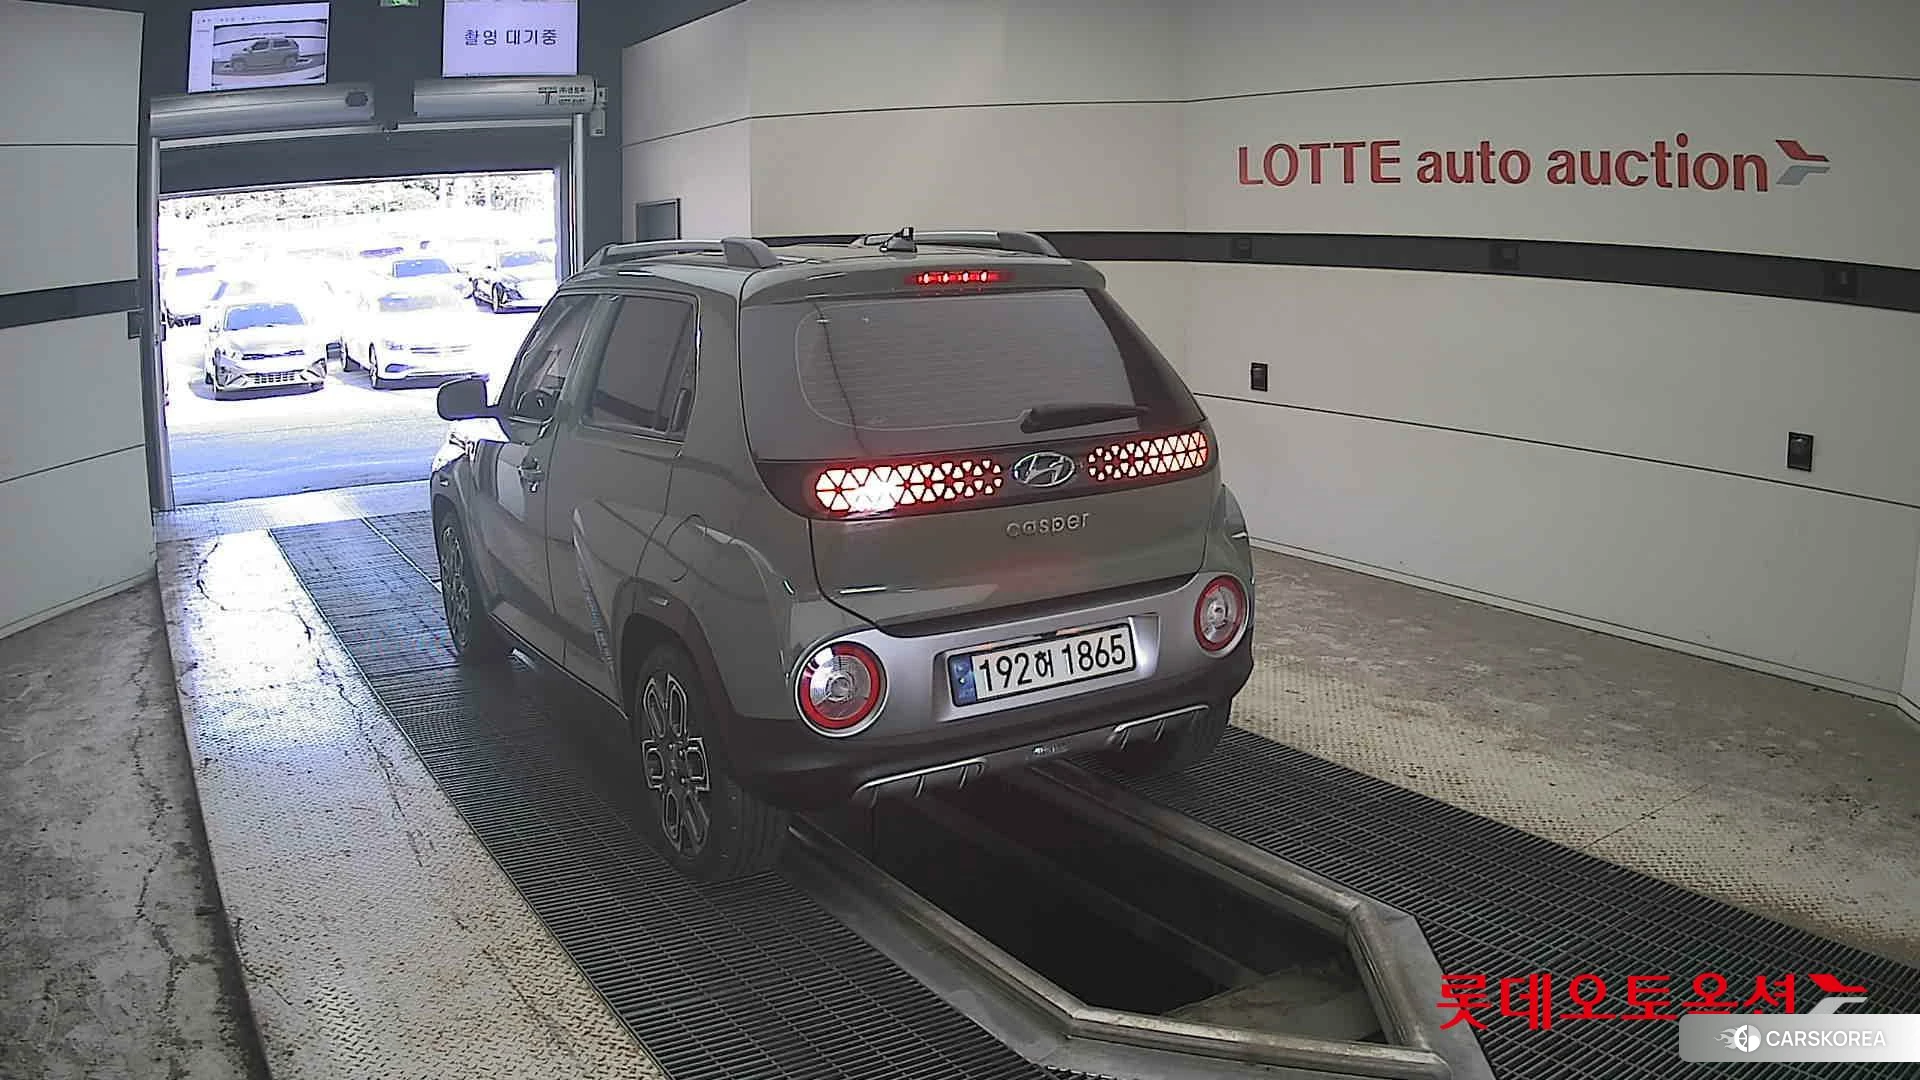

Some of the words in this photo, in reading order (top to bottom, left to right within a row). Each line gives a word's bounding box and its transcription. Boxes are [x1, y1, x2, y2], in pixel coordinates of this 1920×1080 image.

[505, 29, 558, 46] 대기중
[1238, 140, 1401, 187] LOTTE
[1416, 140, 1532, 185] auto
[1546, 132, 1769, 193] auction
[1006, 512, 1089, 537] casper
[978, 648, 1055, 692] 192허
[1061, 633, 1127, 676] 1865
